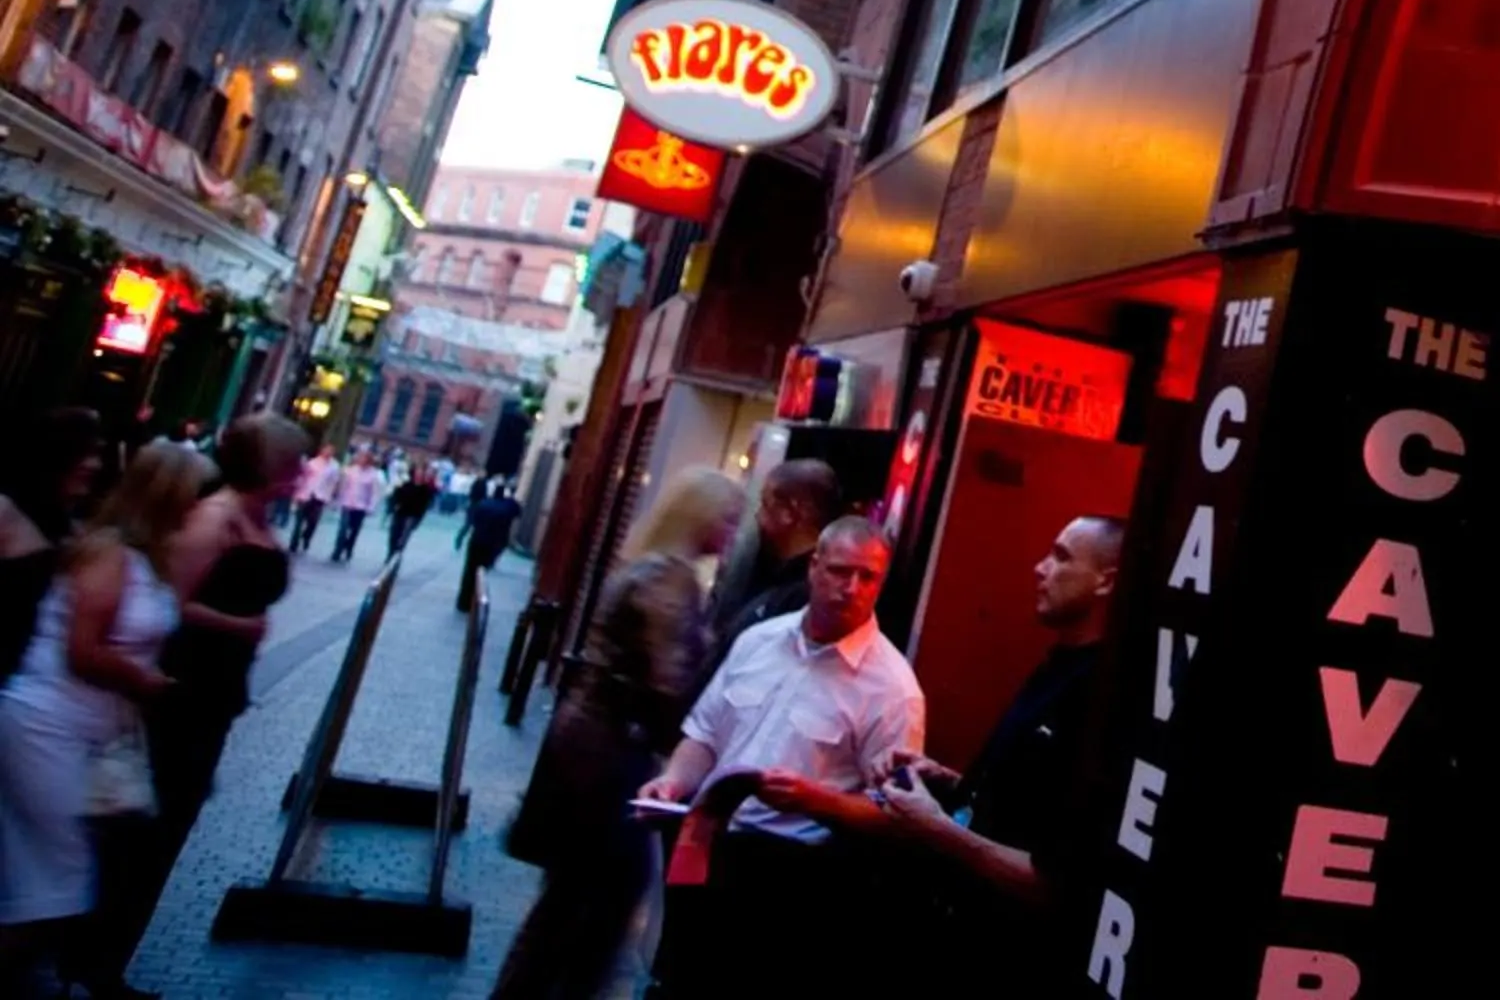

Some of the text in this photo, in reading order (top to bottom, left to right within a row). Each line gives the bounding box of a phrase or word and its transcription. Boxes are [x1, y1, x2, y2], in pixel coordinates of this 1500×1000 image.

[631, 18, 816, 120] flares
[1223, 296, 1274, 347] THE
[1385, 307, 1489, 381] THE
[978, 362, 1098, 420] CAVER
